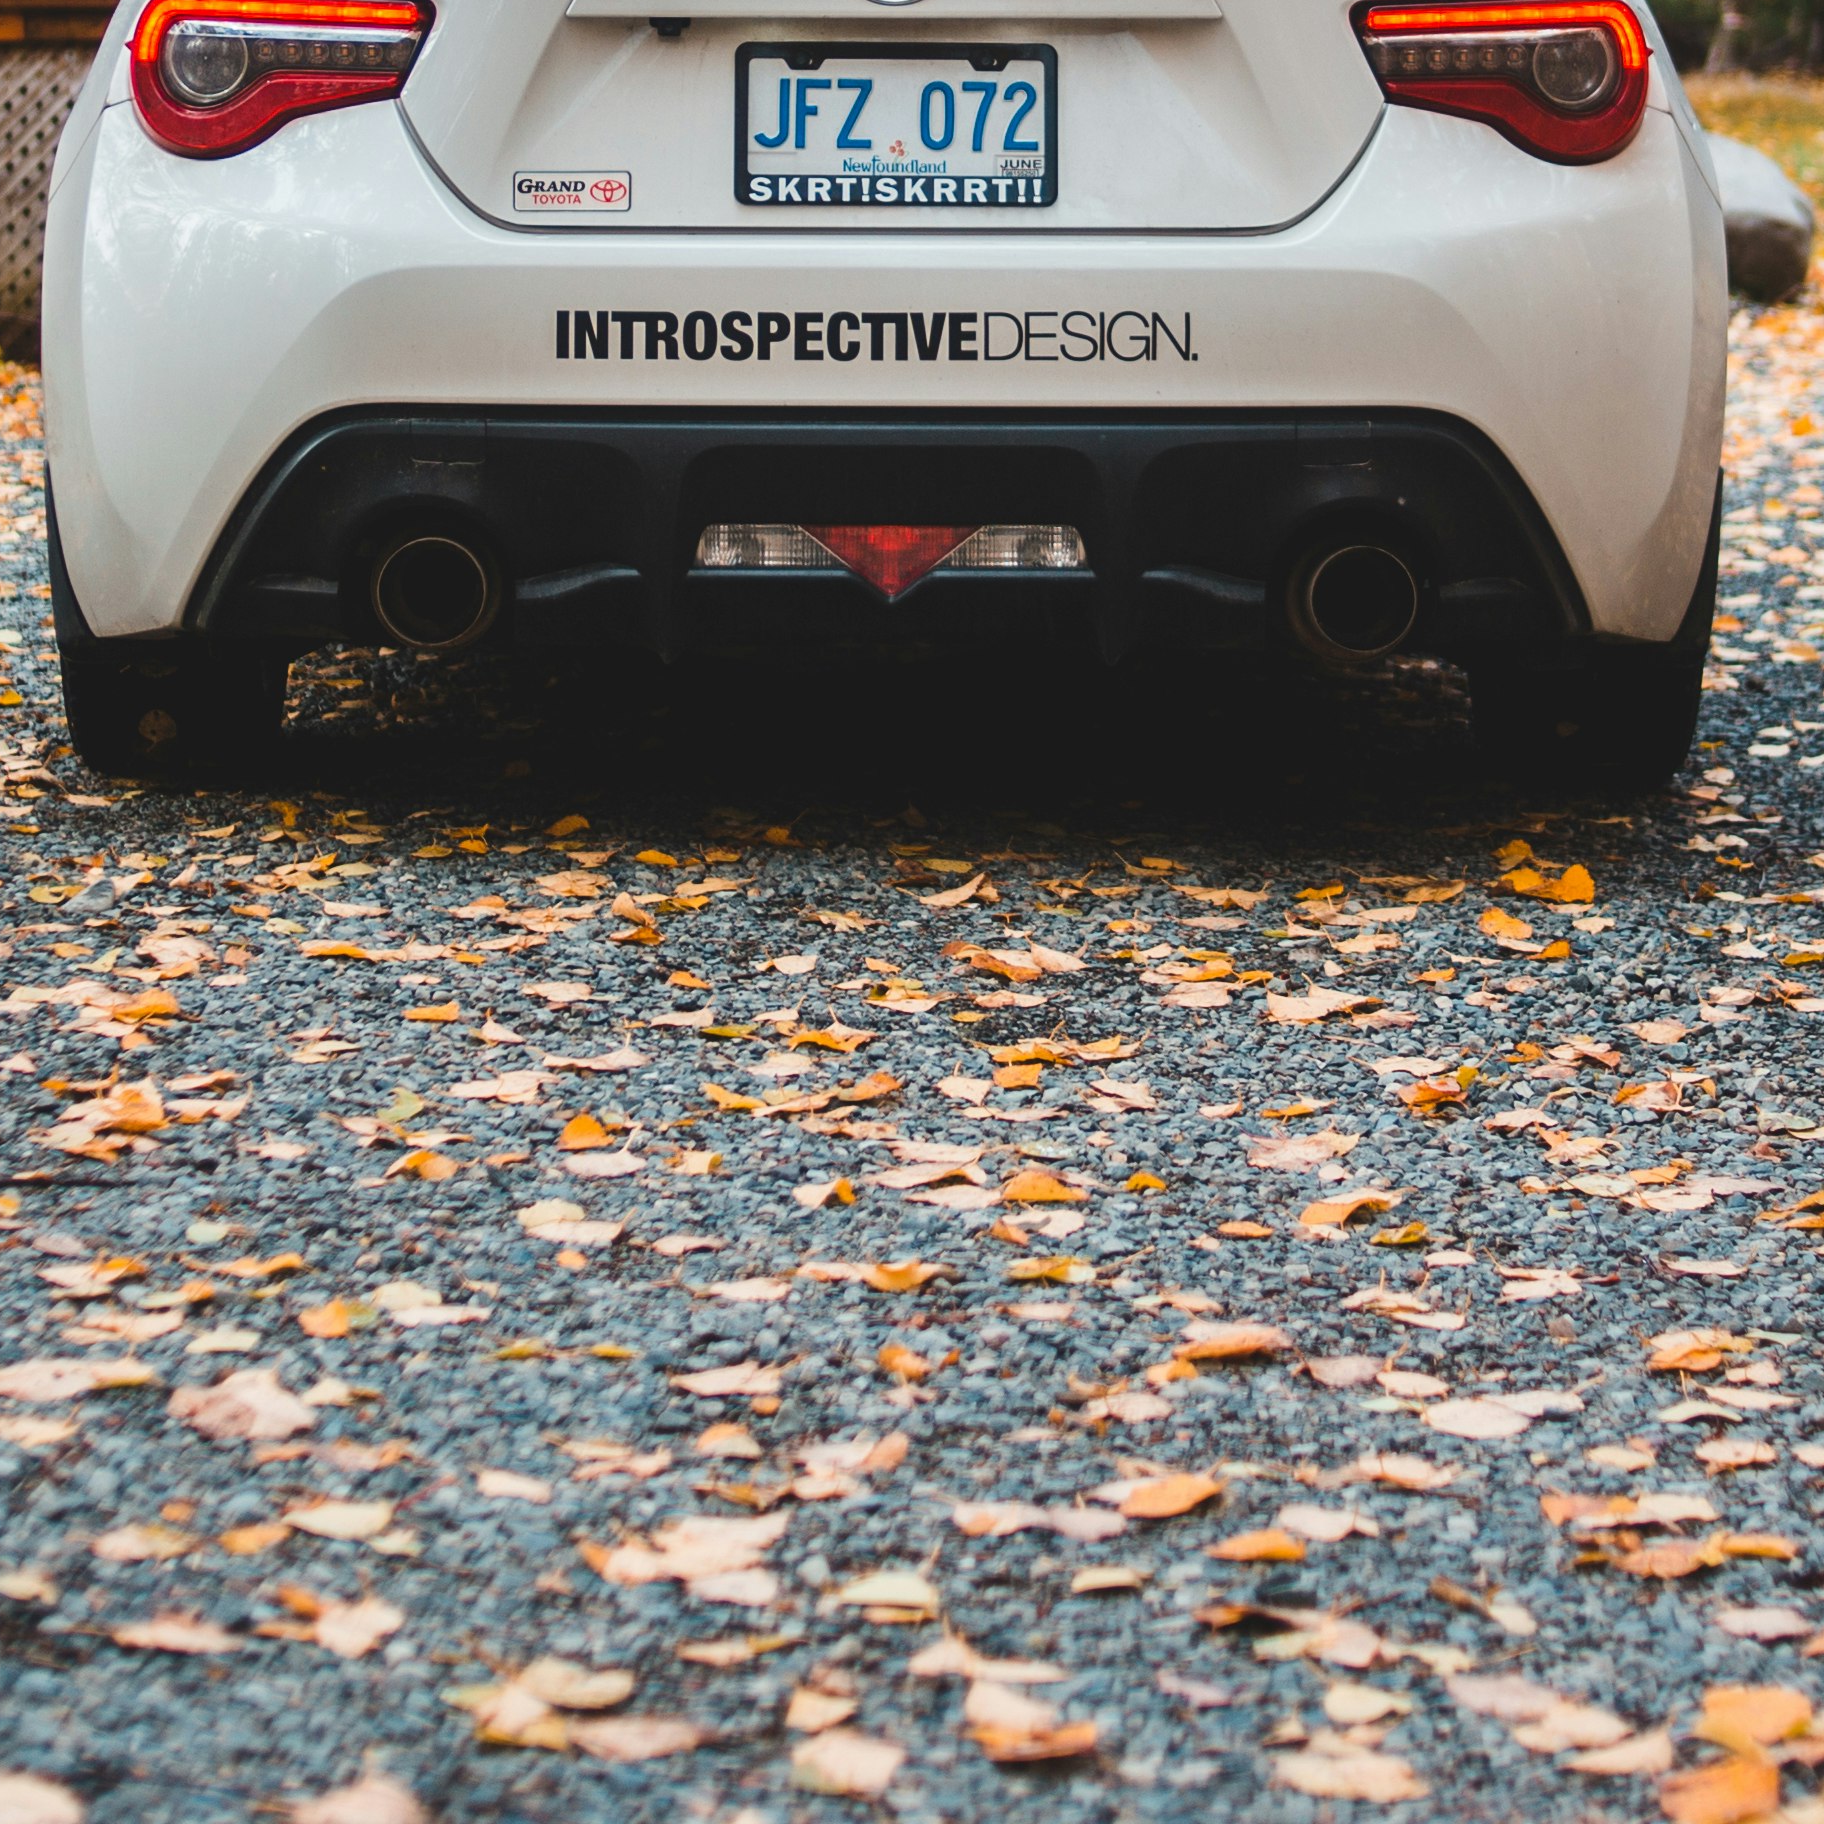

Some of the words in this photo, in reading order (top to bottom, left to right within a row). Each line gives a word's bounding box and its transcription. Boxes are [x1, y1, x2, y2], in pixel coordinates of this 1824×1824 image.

[754, 78, 873, 149] JFZ
[920, 80, 1039, 152] 072
[842, 155, 947, 175] Newfoundland
[1000, 159, 1042, 169] JUNE
[517, 179, 585, 194] GRAND
[532, 194, 581, 204] TOYOTA
